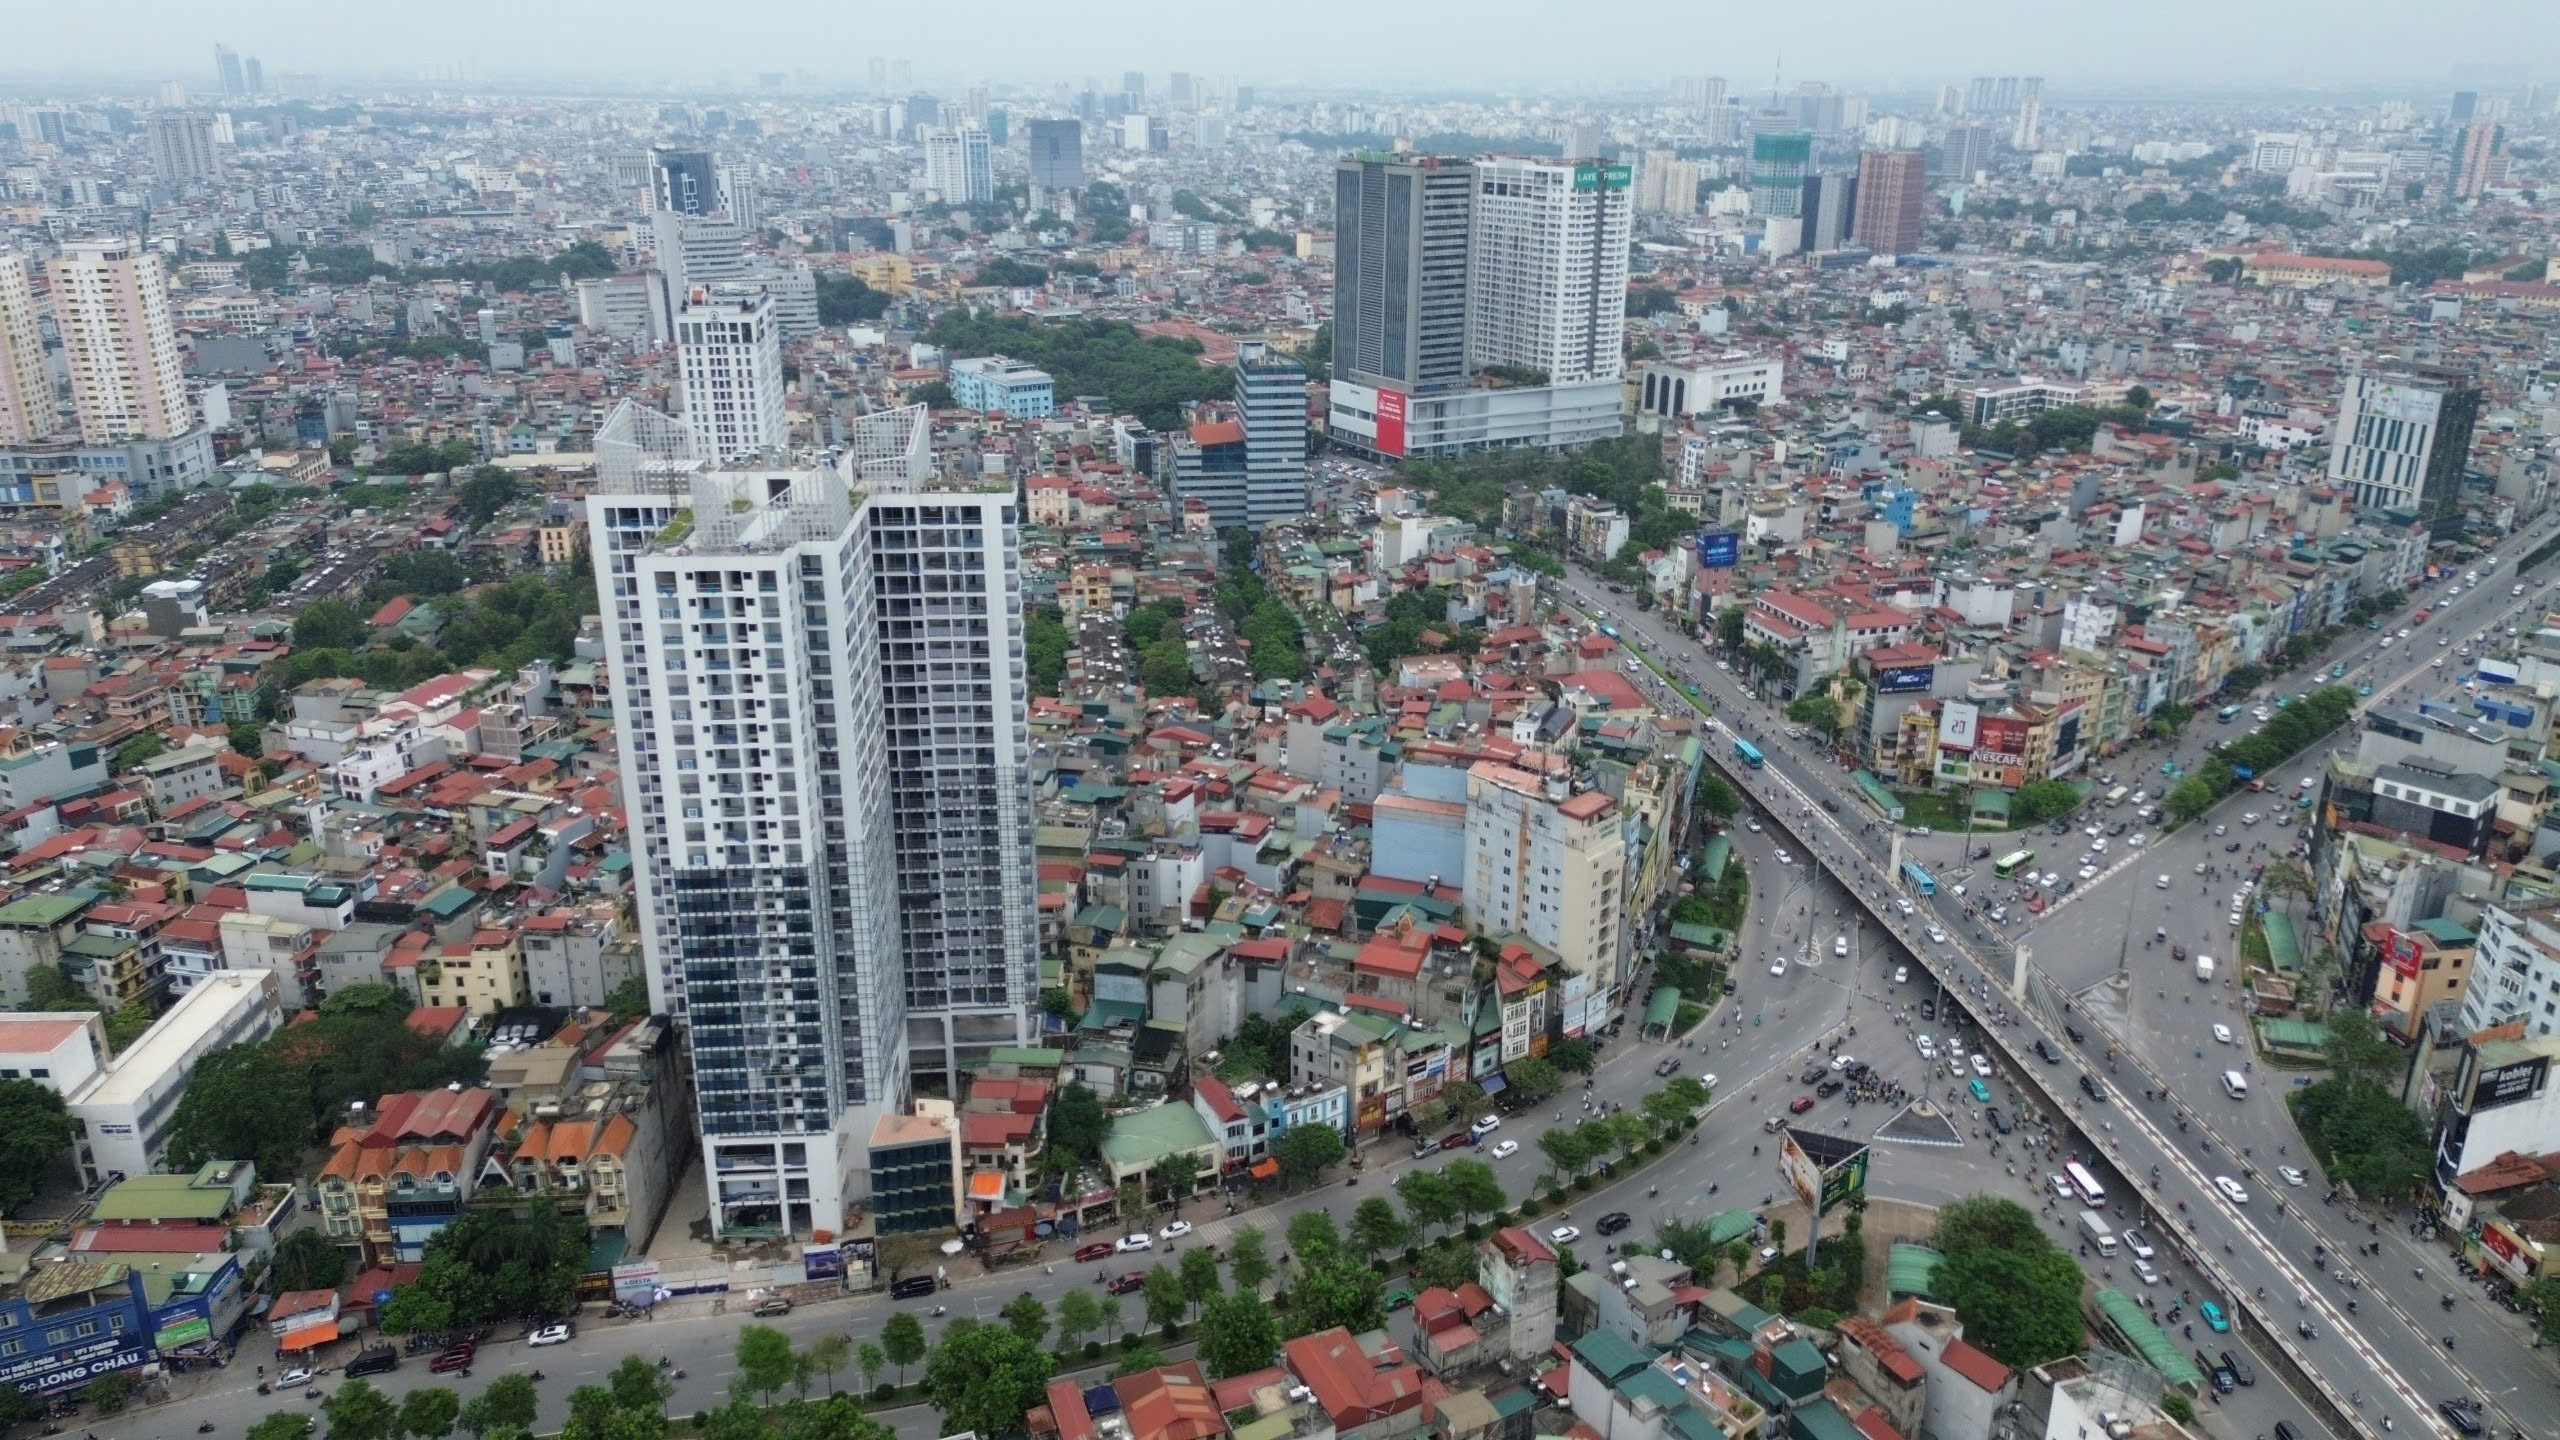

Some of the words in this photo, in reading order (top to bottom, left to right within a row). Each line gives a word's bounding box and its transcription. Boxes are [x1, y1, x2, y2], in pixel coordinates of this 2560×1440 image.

[1603, 171, 1628, 181] FRESH
[40, 1367, 87, 1388] LONG
[91, 1352, 138, 1373] CHÂU
